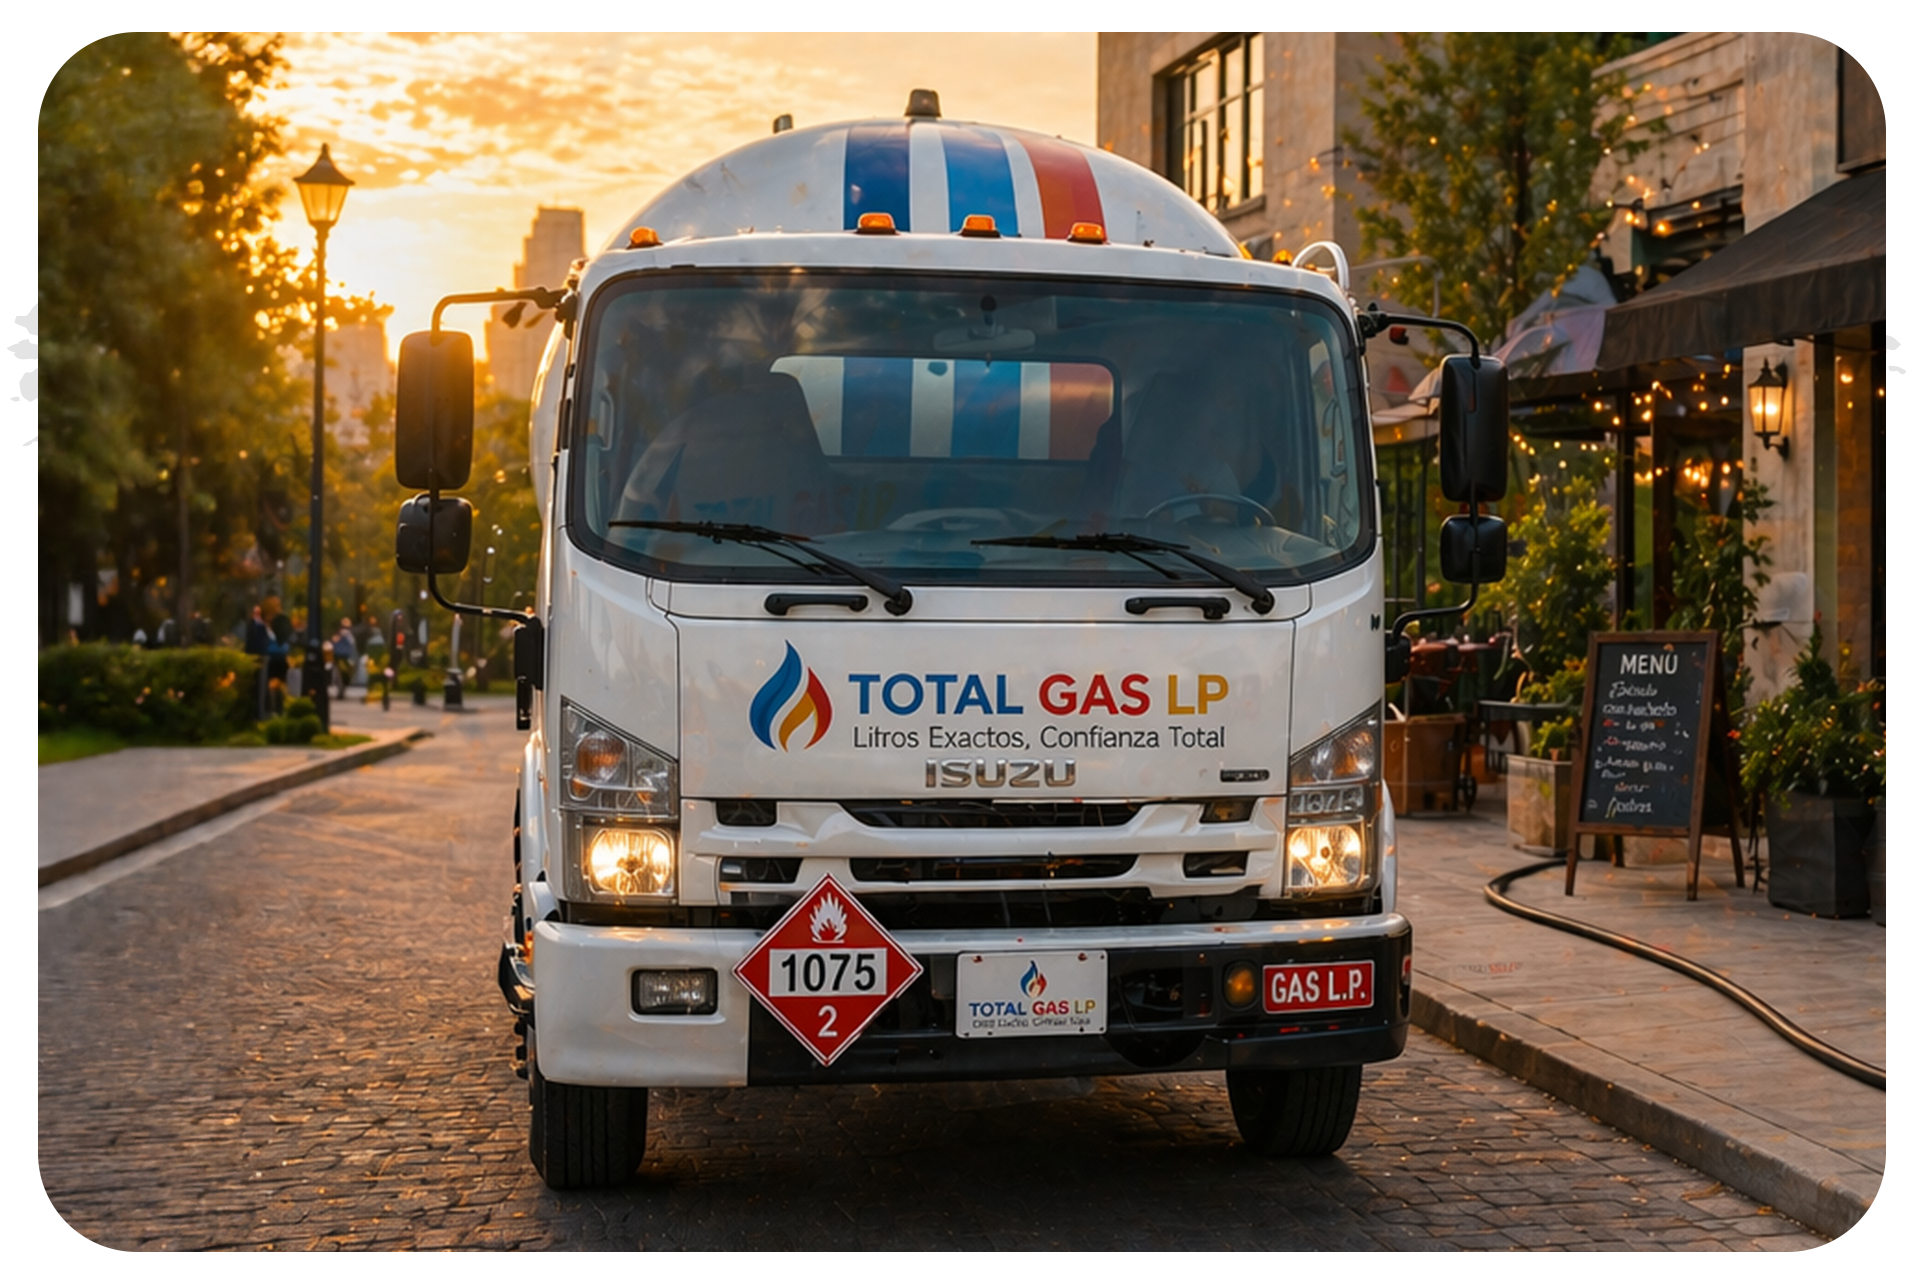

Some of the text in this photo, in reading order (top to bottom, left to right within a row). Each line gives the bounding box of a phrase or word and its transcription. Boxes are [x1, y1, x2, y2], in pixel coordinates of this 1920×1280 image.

[848, 673, 1229, 716] TOTAL GAS LP
[853, 725, 1225, 750] Litros Exactos, Confianza Total
[925, 758, 1076, 788] ISUZU
[781, 953, 876, 992] 1075
[1271, 968, 1366, 1004] GAS L.P.
[817, 1004, 838, 1037] 2
[968, 999, 1097, 1017] TOTAL GAS LP
